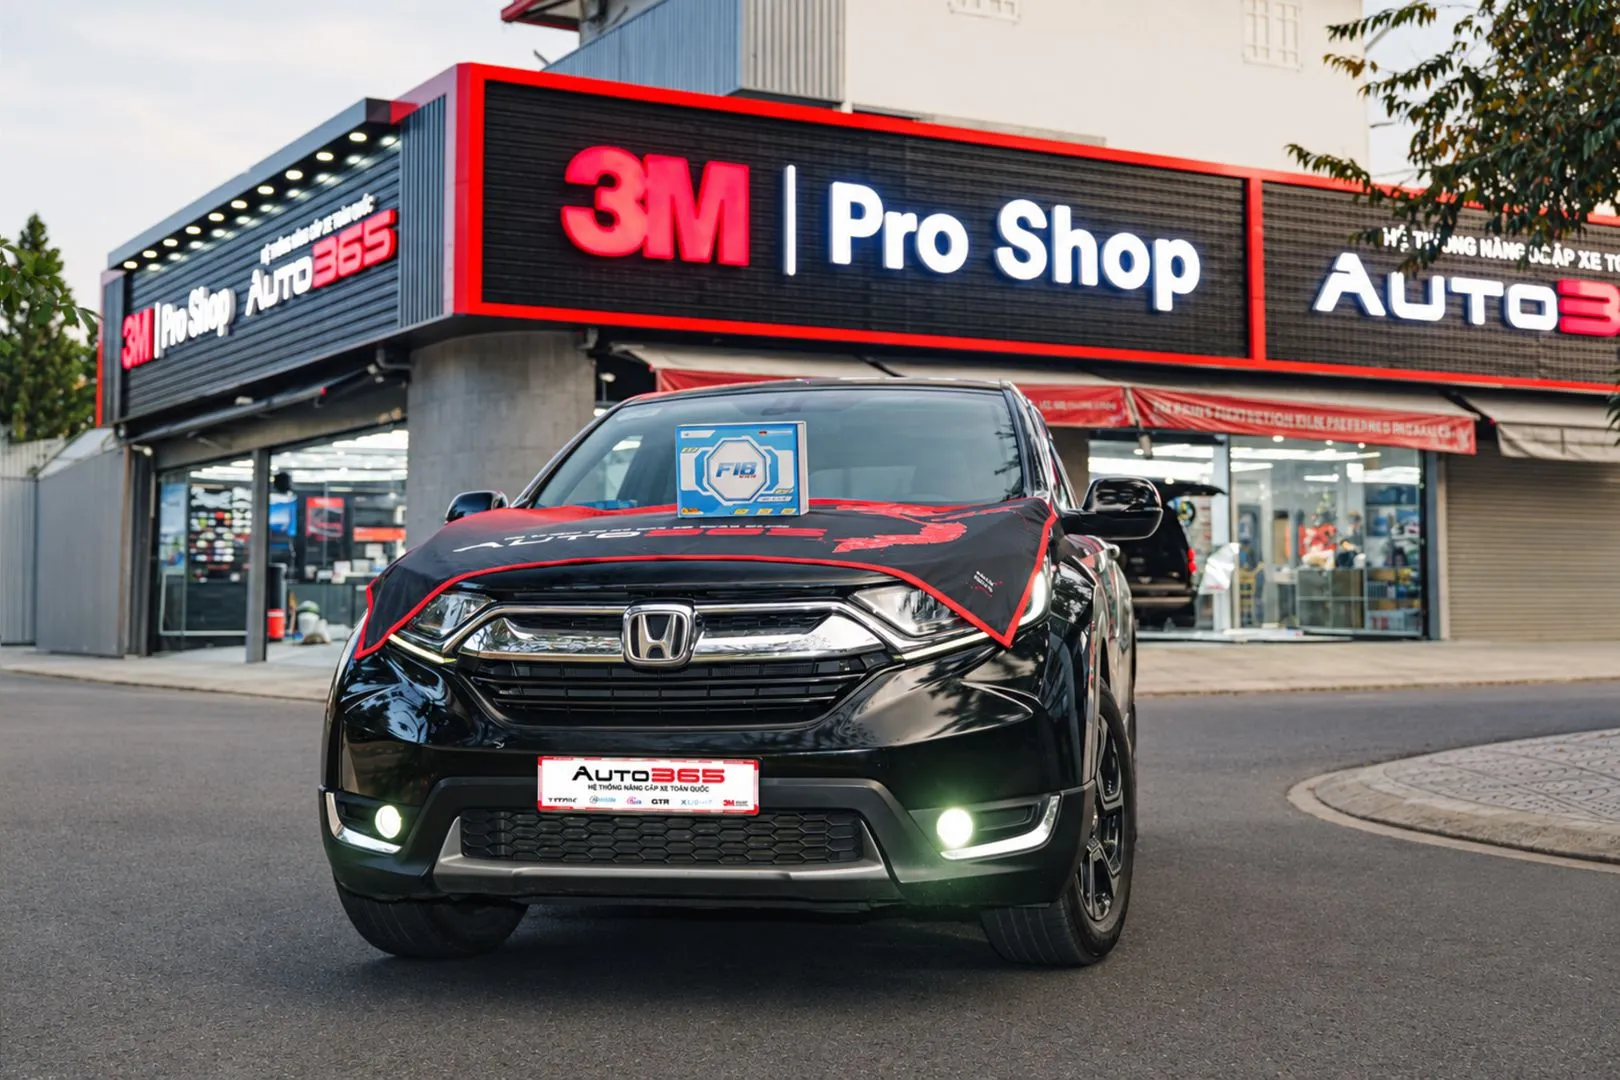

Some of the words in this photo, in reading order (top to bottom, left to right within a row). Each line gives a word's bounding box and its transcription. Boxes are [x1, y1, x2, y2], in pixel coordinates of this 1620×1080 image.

[561, 145, 750, 266] 3M
[828, 181, 969, 274] Pro
[995, 198, 1201, 312] Shop
[1578, 251, 1602, 271] XE
[121, 306, 154, 371] 3M
[161, 303, 188, 349] Pro
[188, 286, 236, 337] Shop
